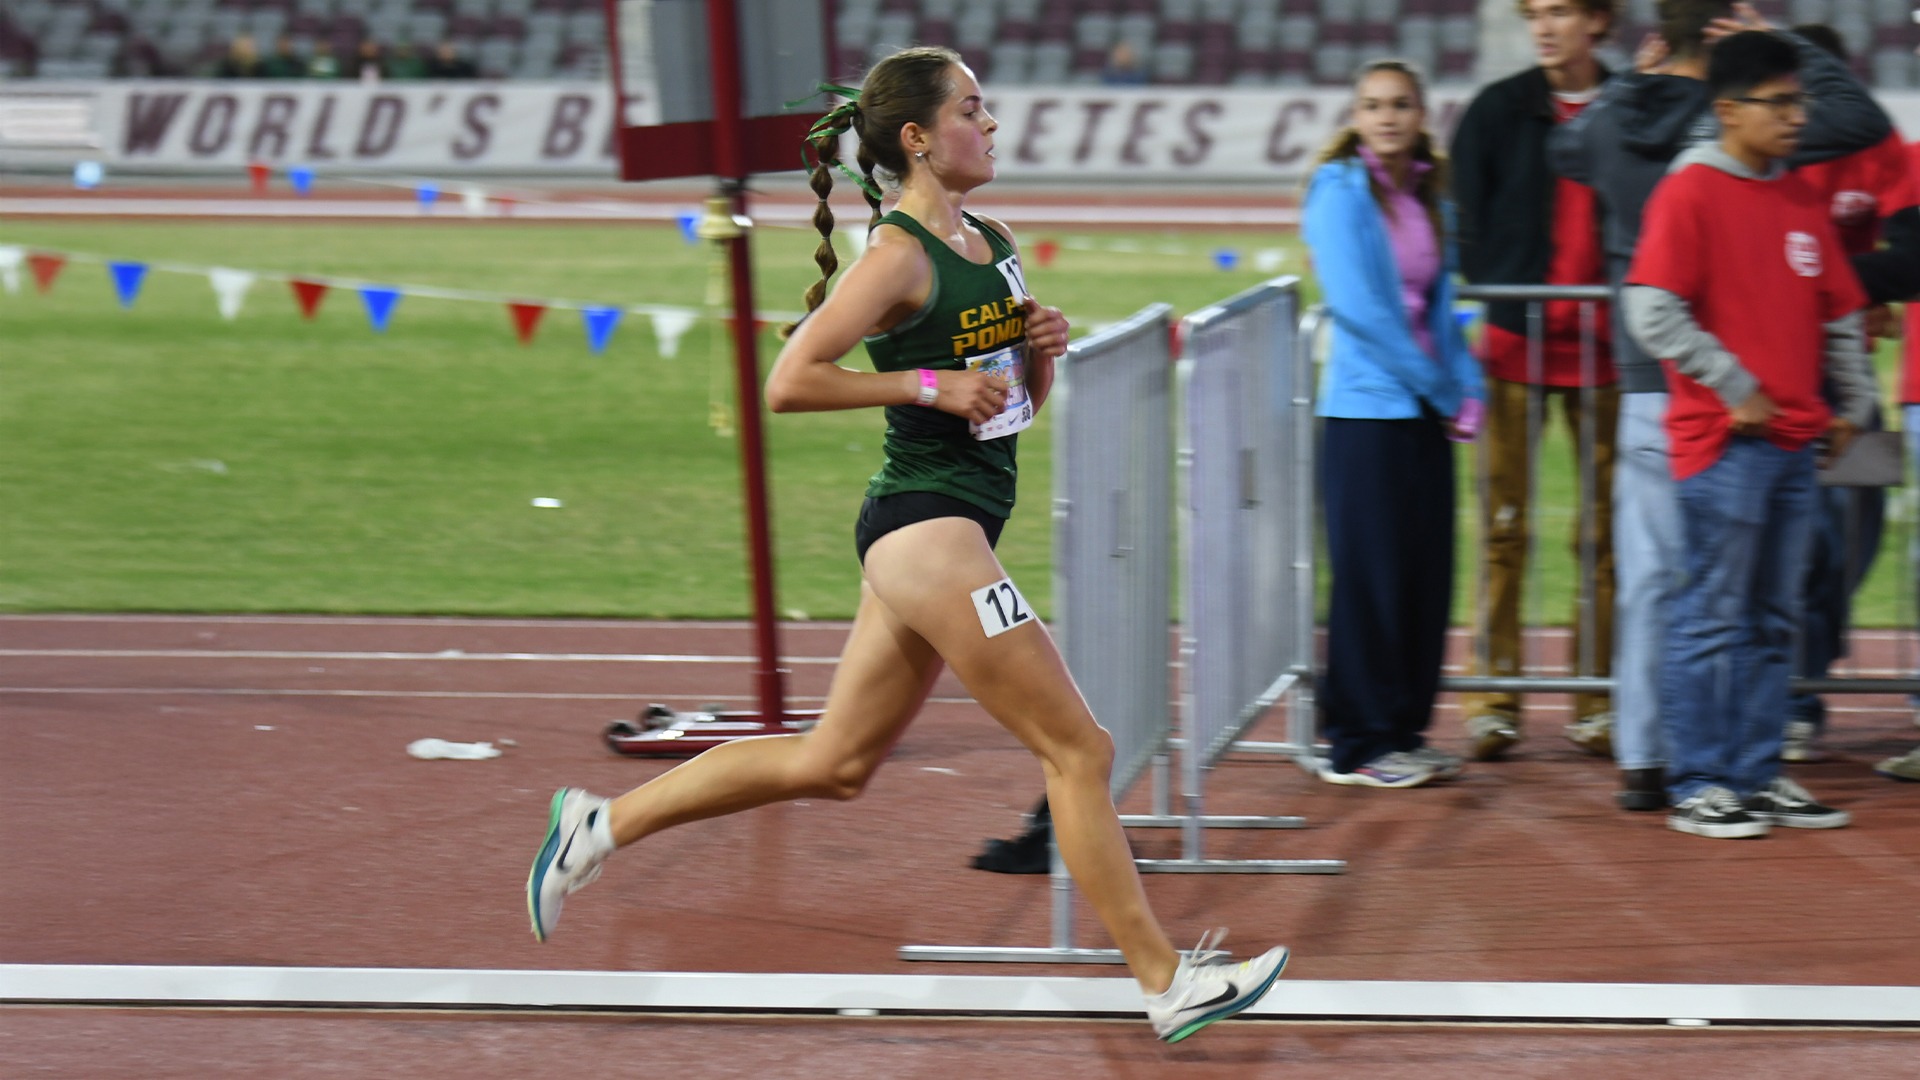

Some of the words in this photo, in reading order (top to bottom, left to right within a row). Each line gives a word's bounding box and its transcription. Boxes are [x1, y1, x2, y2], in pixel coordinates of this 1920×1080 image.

[120, 93, 501, 159] WORLD'S
[988, 98, 1224, 163] ETES
[959, 301, 1005, 330] CAL
[985, 582, 1028, 628] 12
